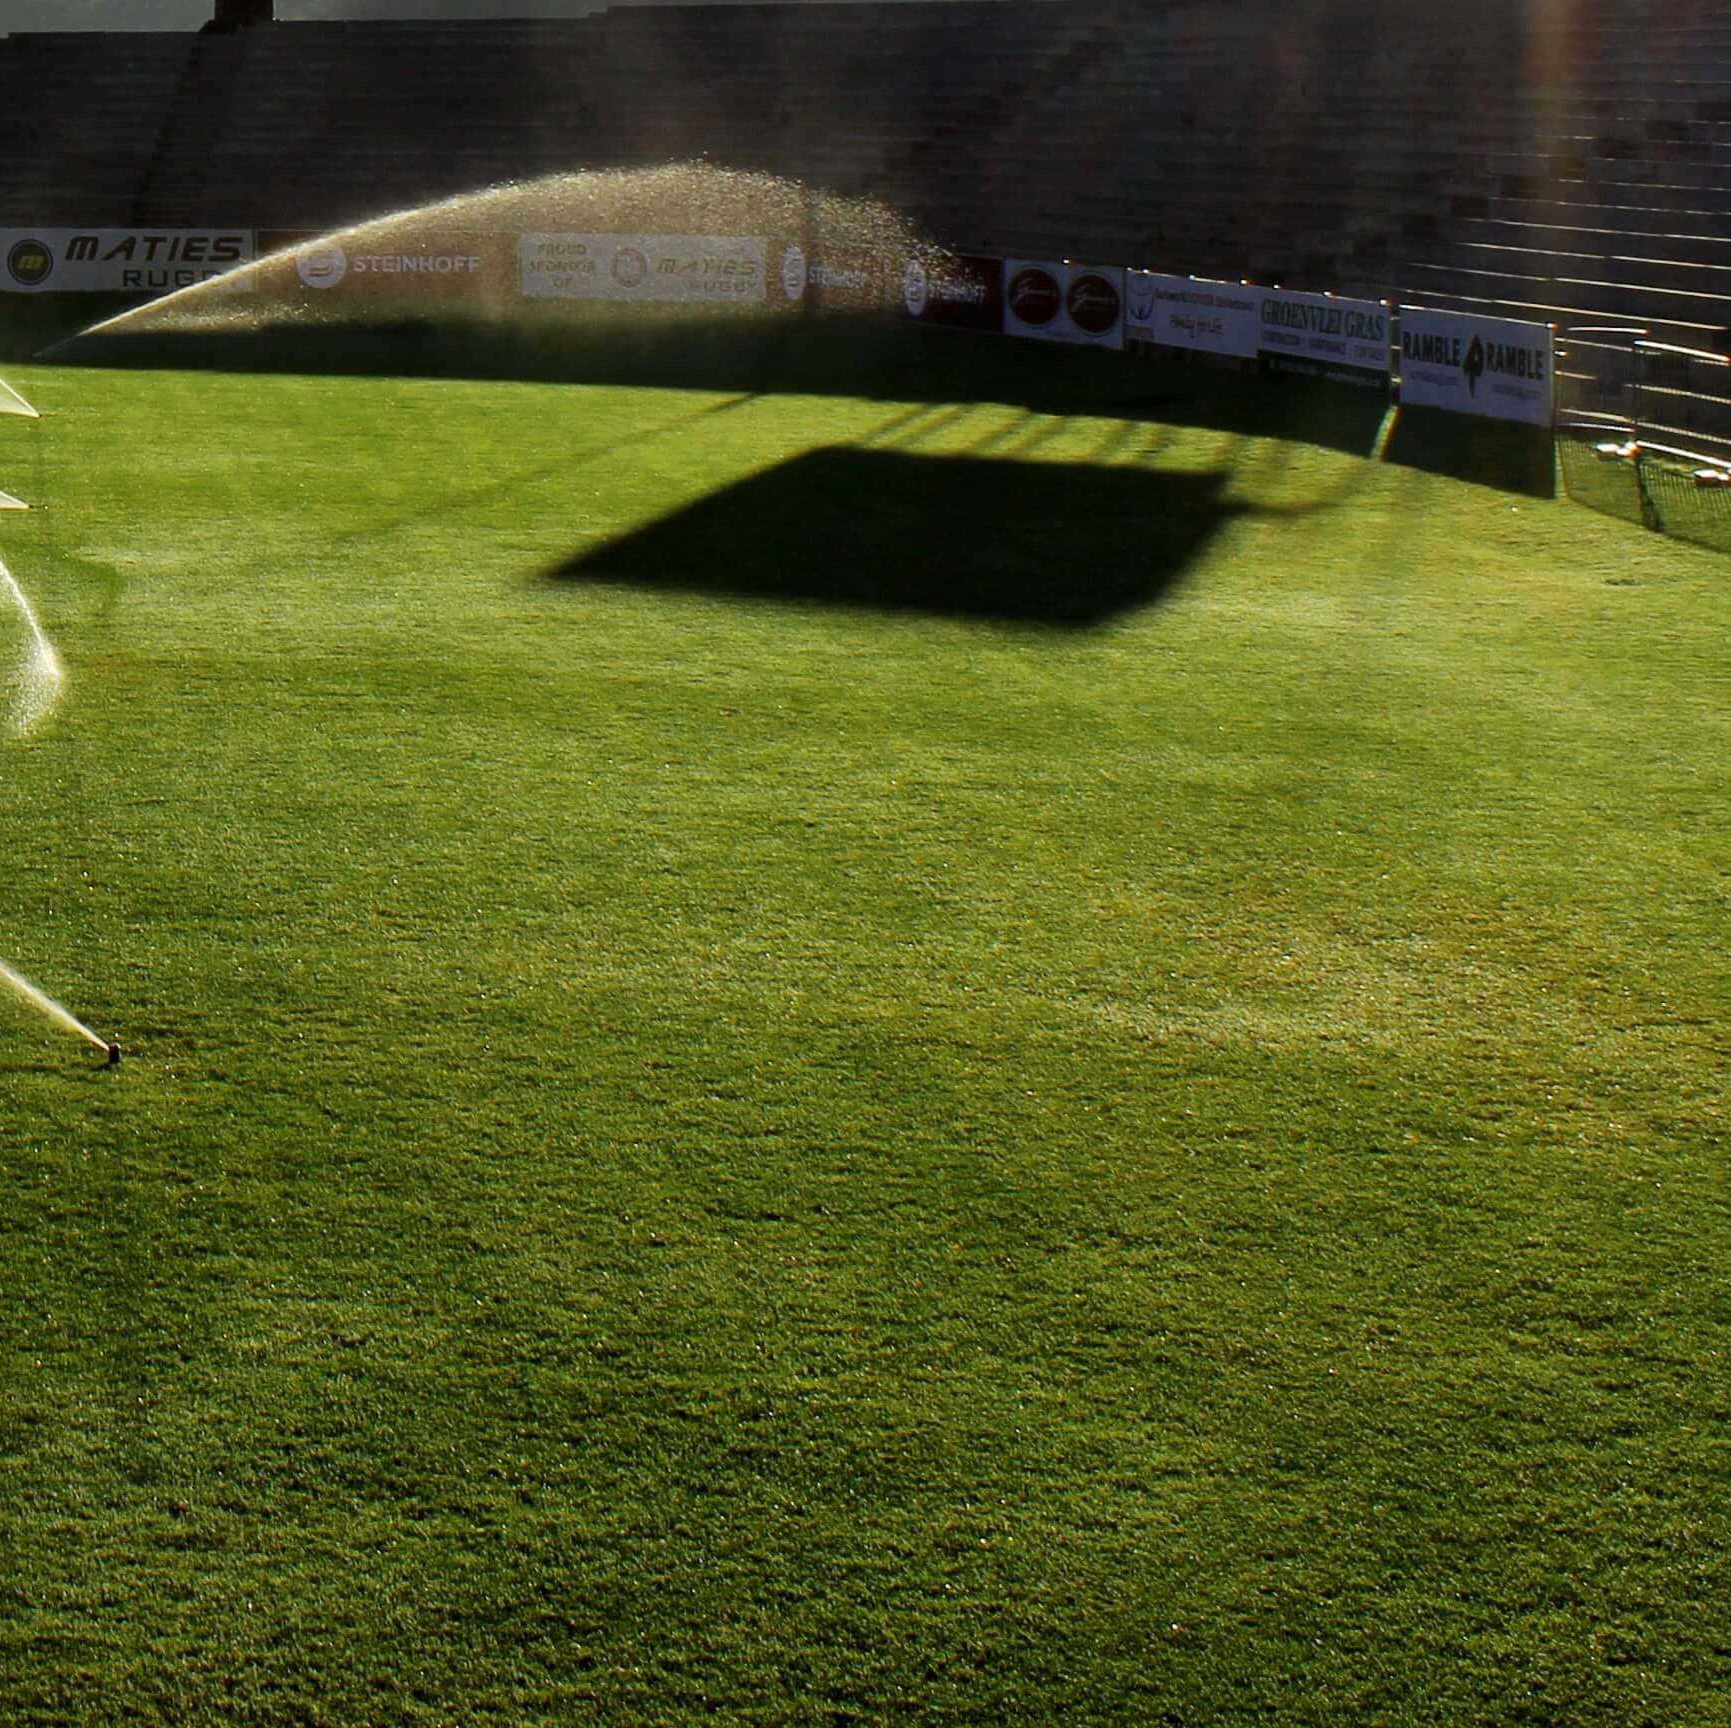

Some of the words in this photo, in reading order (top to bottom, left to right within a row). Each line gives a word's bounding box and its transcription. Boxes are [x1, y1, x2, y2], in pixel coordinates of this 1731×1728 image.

[65, 235, 244, 262] MATIES
[352, 255, 481, 273] STEINHOFF
[1261, 299, 1343, 335] GROENVLEI
[1345, 310, 1384, 342] GRAS
[1403, 331, 1461, 367] RAMBLE
[1486, 342, 1543, 380] RAMBLE
